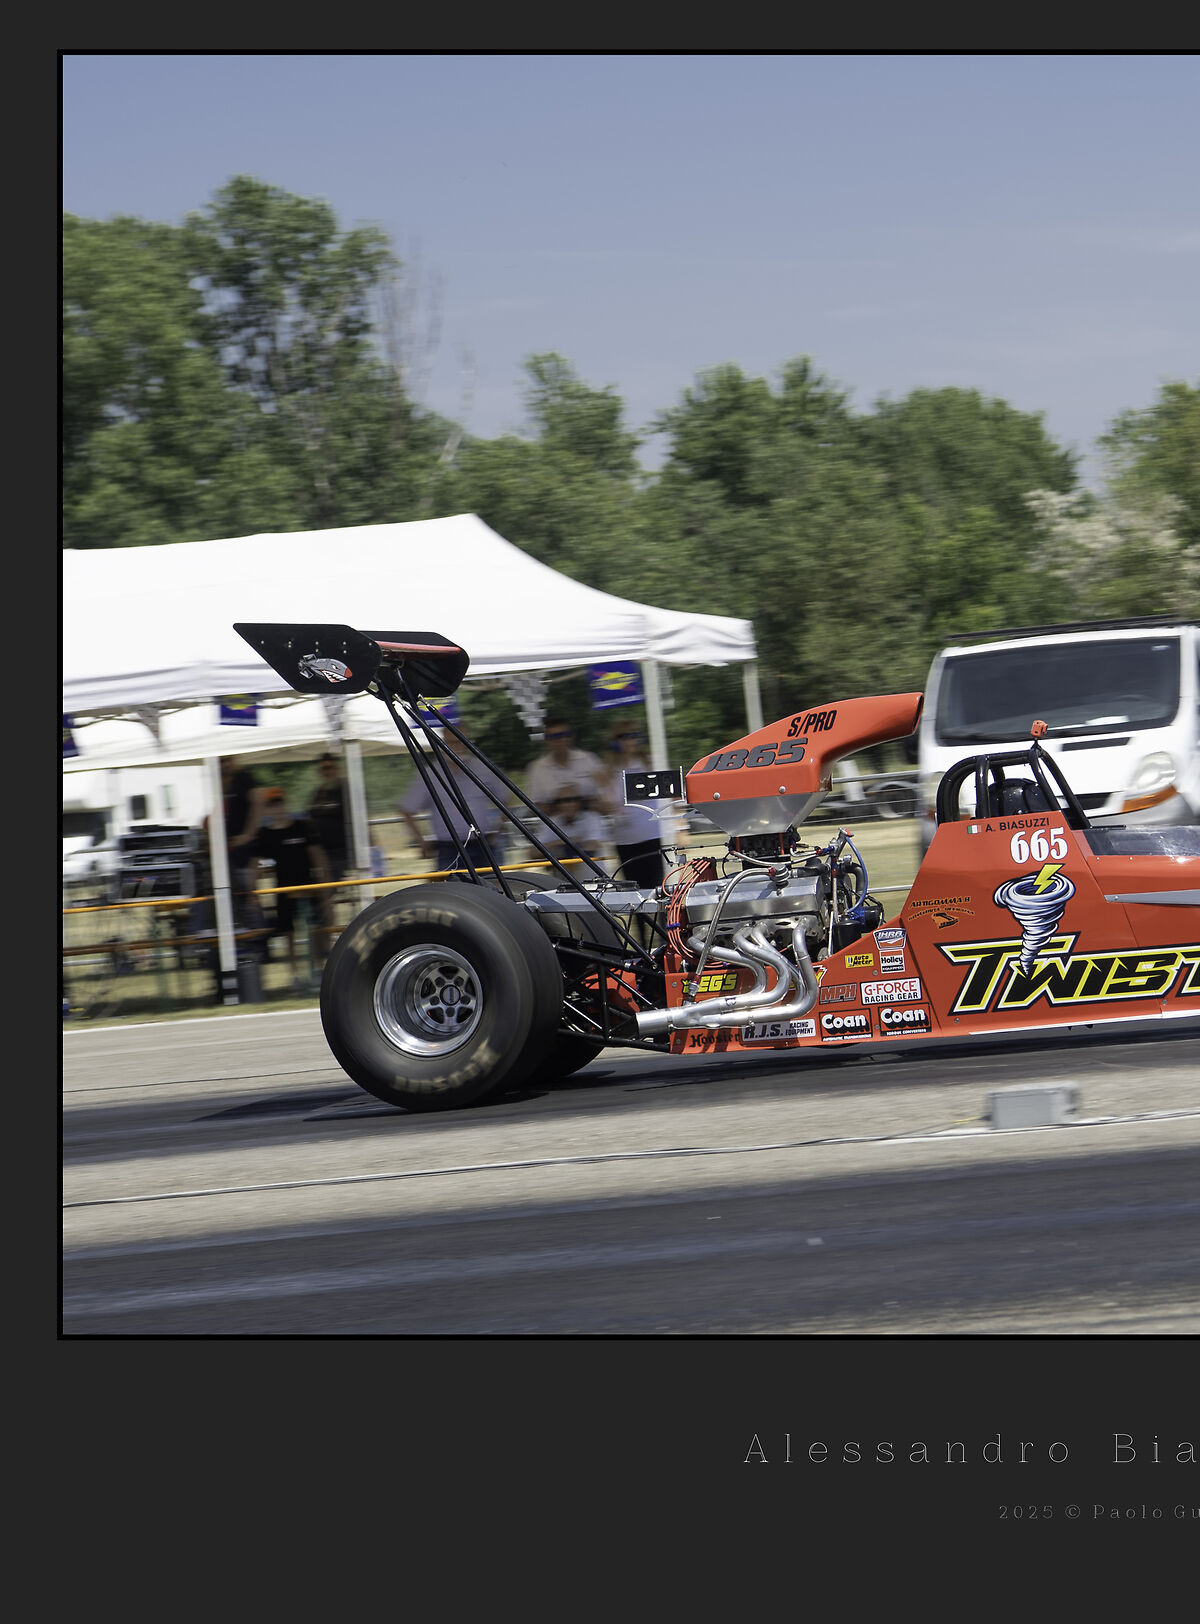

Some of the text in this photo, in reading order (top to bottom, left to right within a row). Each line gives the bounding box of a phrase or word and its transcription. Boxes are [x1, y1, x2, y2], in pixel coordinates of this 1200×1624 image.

[787, 710, 838, 738] S/PRO
[985, 817, 1050, 832] A. BIASUZZI
[1010, 826, 1069, 864] 665
[878, 931, 904, 939] IHRA
[881, 956, 903, 965] Holley
[820, 983, 857, 1001] MPH
[864, 980, 917, 996] G-FORCE
[864, 992, 919, 1003] RACING GEAR
[821, 1013, 867, 1030] Coan
[880, 1008, 926, 1025] Coan
[744, 1024, 784, 1039] R.J.S.
[785, 1027, 814, 1036] EQUIPMENT
[789, 1021, 809, 1029] RACING
